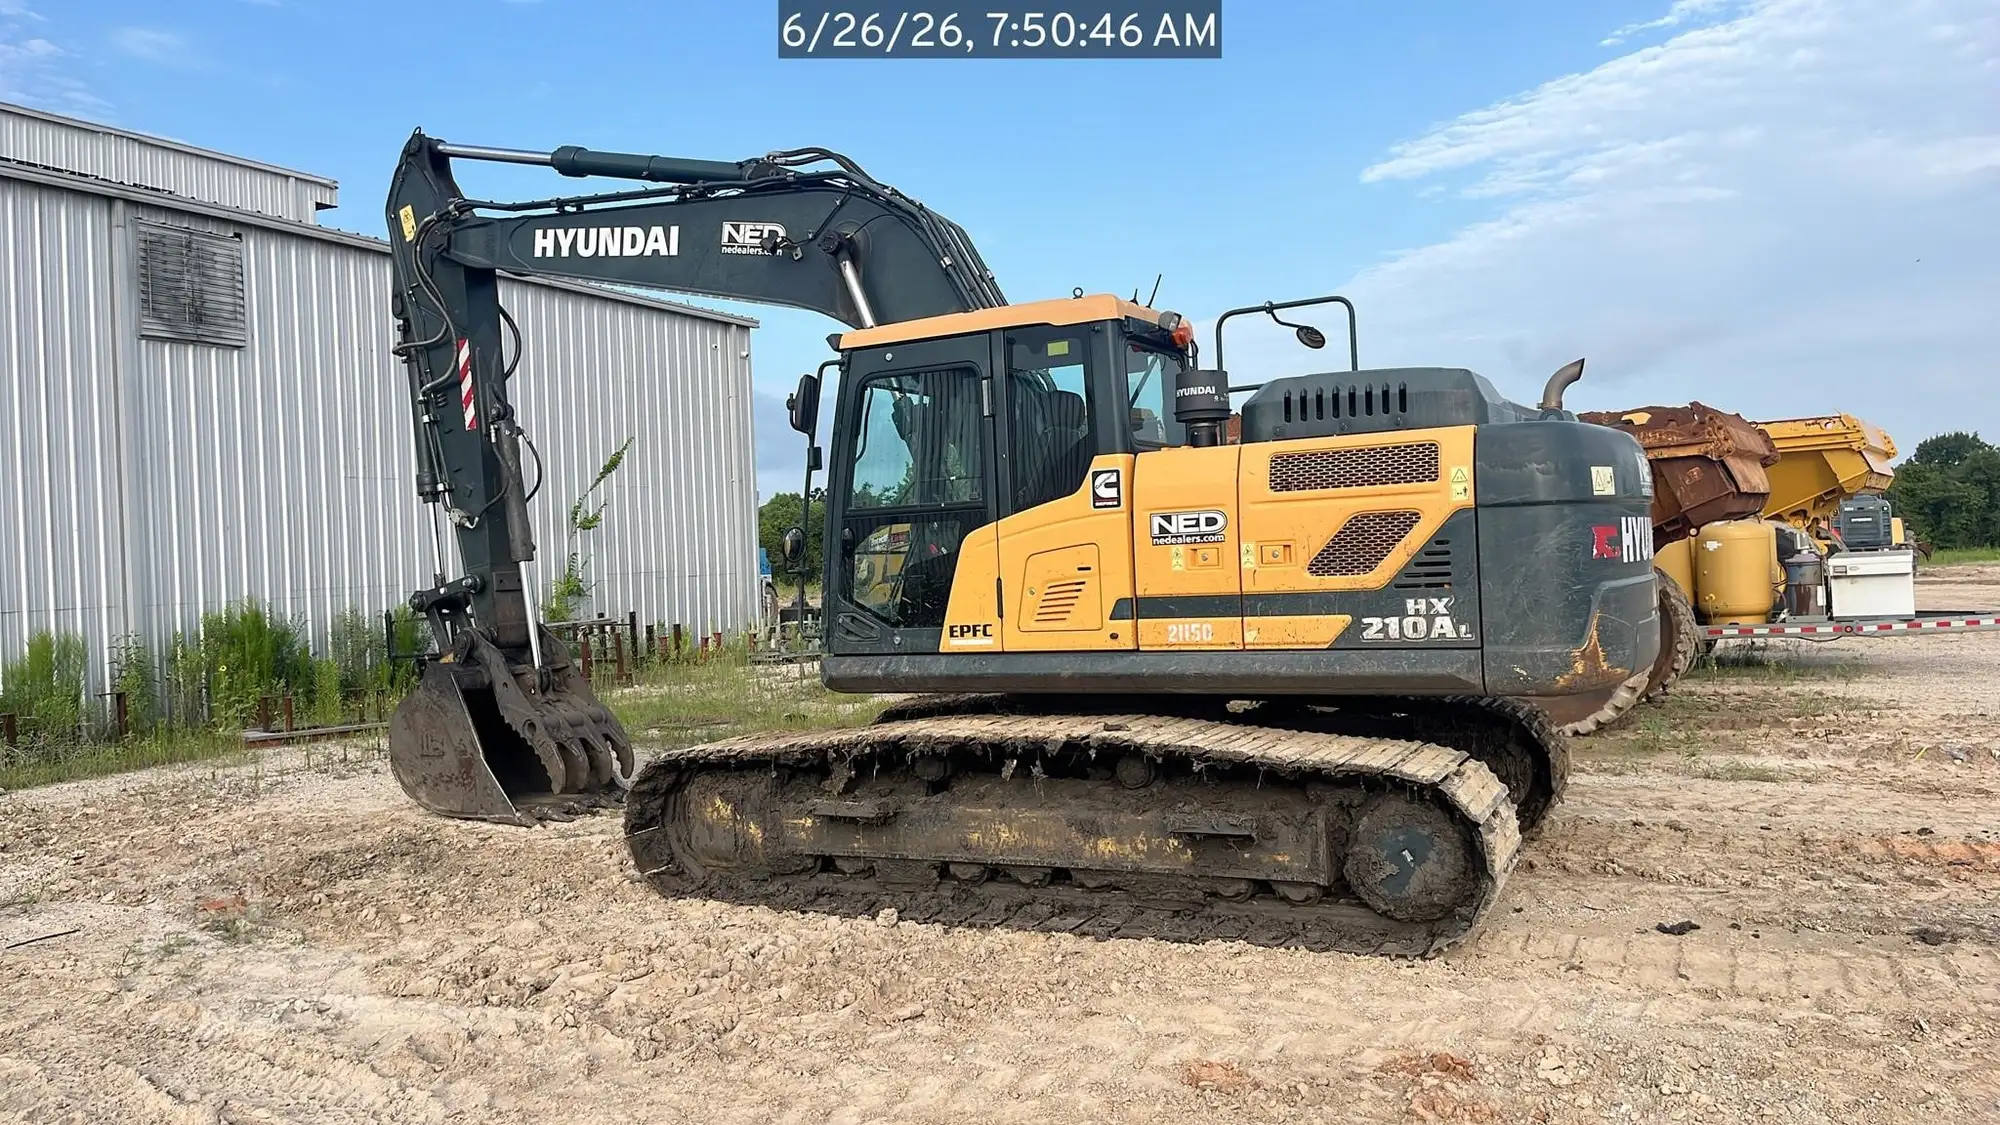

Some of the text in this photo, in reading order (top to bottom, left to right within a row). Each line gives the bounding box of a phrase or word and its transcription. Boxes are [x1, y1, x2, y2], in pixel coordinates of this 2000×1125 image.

[533, 225, 679, 258] HYUNDAI
[722, 222, 786, 245] NED
[1151, 511, 1225, 536] NED
[1153, 534, 1225, 546] nedealers.com
[1405, 597, 1451, 616] HX
[949, 624, 993, 638] EPFC
